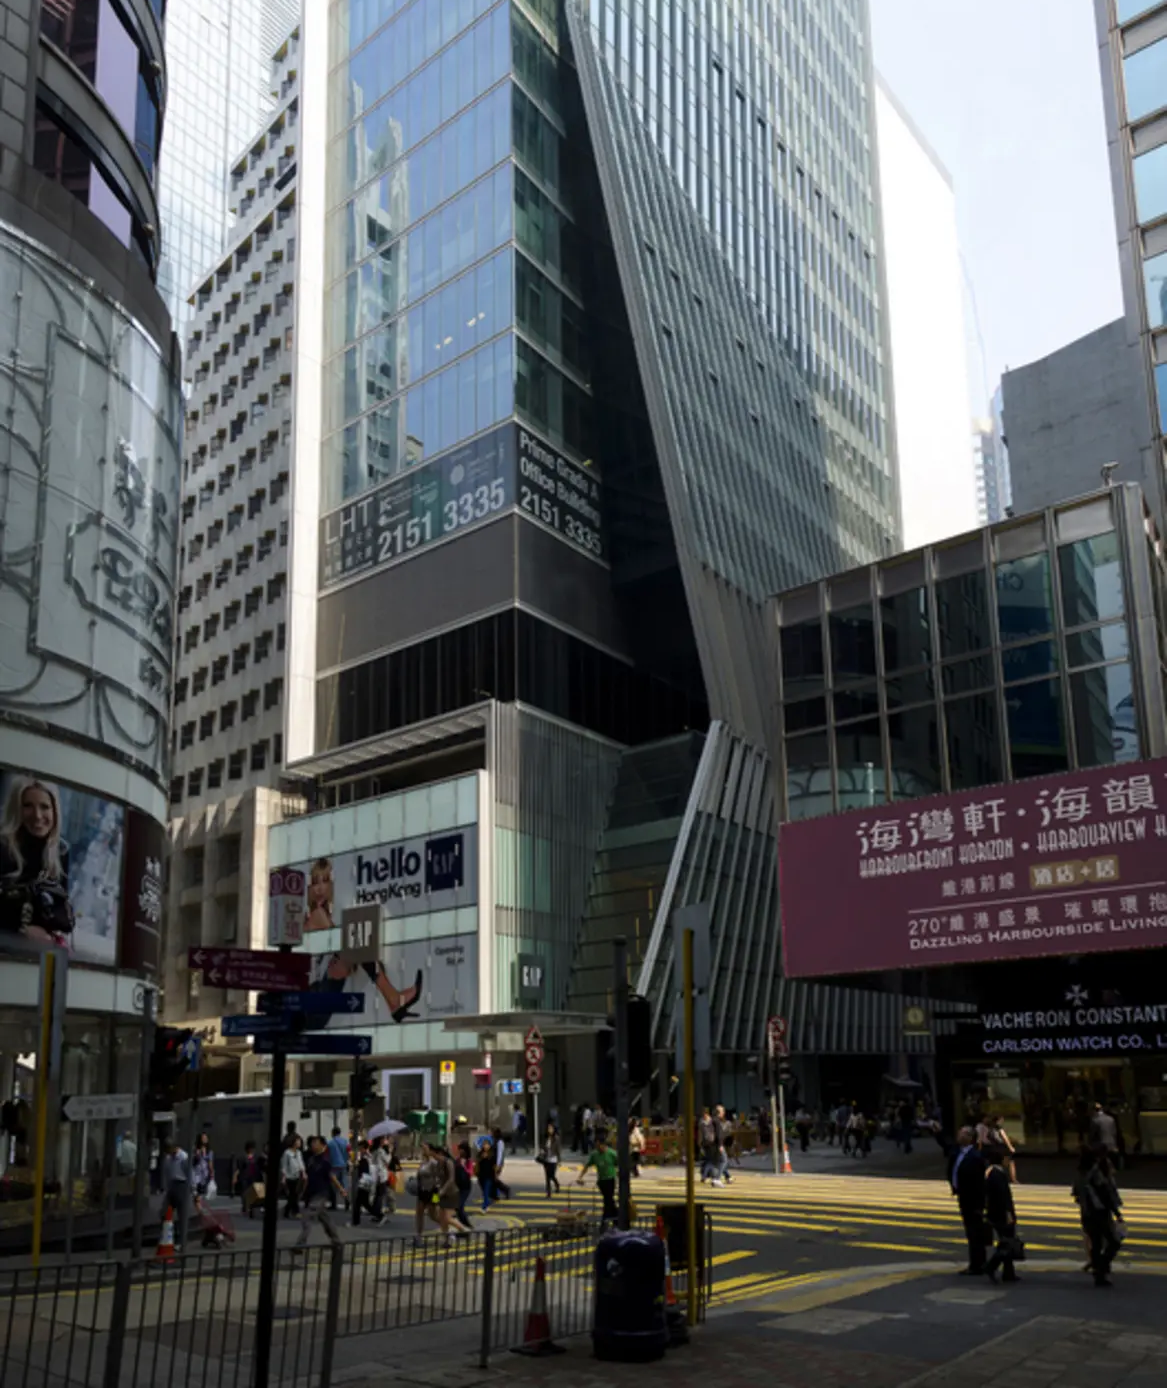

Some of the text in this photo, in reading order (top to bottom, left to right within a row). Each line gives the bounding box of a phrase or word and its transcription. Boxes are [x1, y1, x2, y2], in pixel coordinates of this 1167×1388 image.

[520, 430, 555, 470] Prime
[557, 457, 589, 494] Grade
[590, 482, 600, 502] A
[520, 457, 555, 495] Office
[557, 480, 602, 529] Building
[325, 497, 374, 544] LHT
[378, 511, 432, 562] 2151
[443, 478, 505, 532] 3335
[520, 485, 604, 556] 2151 3335
[357, 846, 420, 885] hello
[859, 845, 954, 878] HARBOURFRONT
[959, 837, 1014, 865] HORIZON
[1036, 816, 1147, 853] HARBOURVIEW
[348, 921, 372, 949] GAP
[909, 932, 984, 951] DAZZLING
[988, 921, 1104, 944] HARBOURSIDE
[522, 965, 542, 987] GAP
[981, 1009, 1071, 1030] VACHERON
[982, 1038, 1053, 1054] CARLSON
[1055, 1036, 1113, 1052] WATCH
[1156, 1033, 1167, 1049] L
